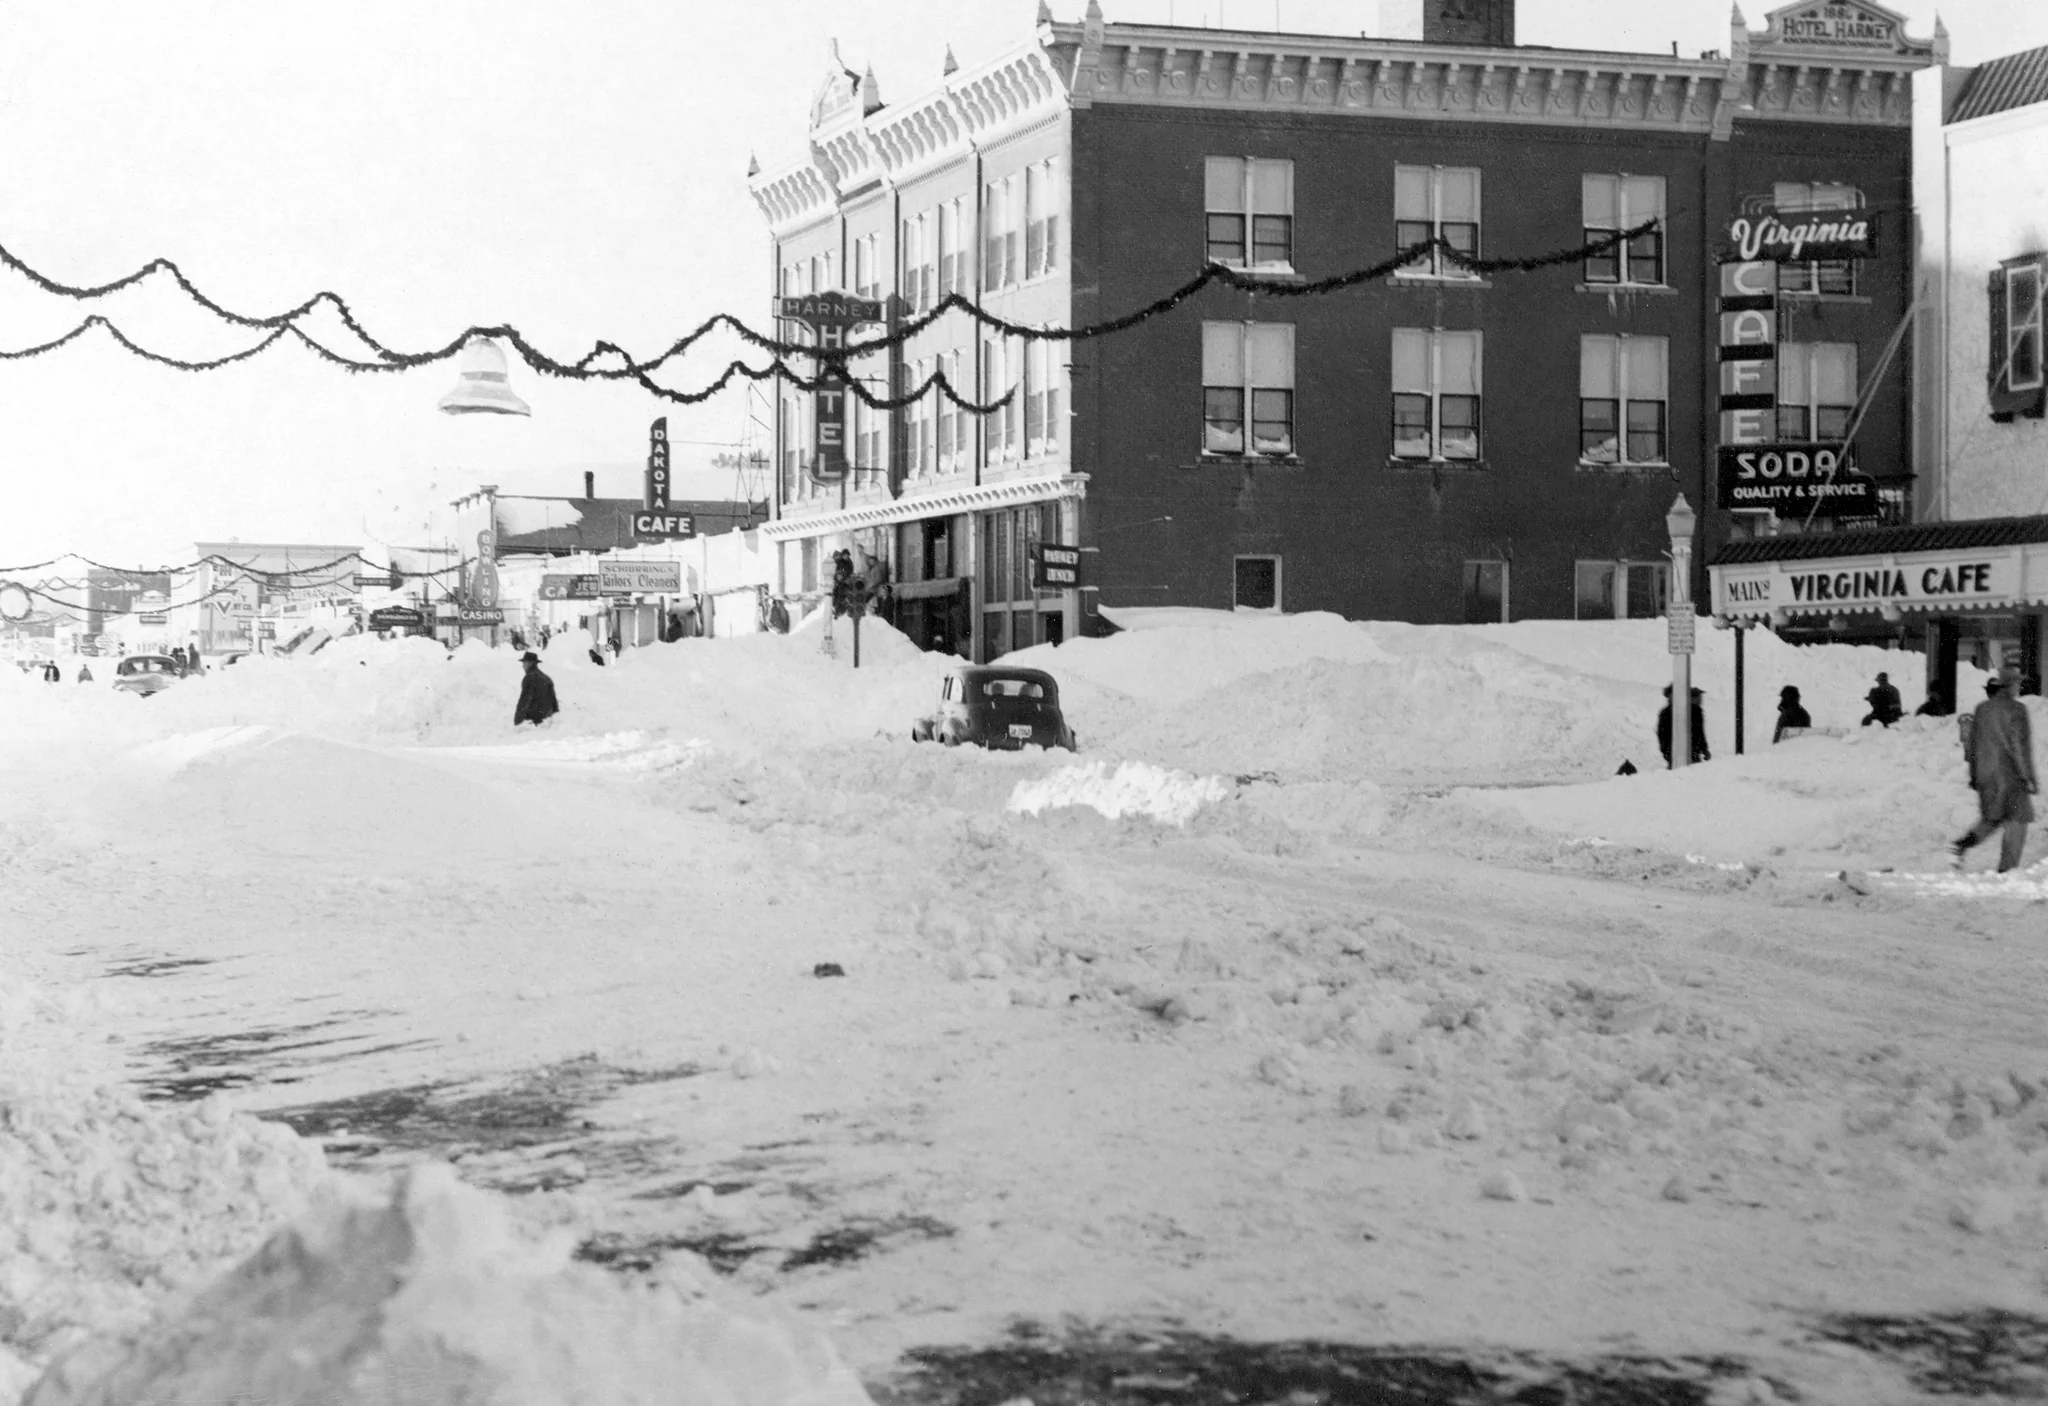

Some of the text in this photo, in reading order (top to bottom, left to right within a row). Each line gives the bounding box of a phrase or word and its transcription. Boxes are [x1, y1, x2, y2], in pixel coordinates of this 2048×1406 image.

[1783, 18, 1893, 40] HOTEL HARNEY
[1731, 215, 1867, 260] Virginia
[787, 301, 876, 317] HARNEY
[1733, 260, 1768, 444] CAFE
[819, 325, 842, 477] HTEL
[654, 430, 665, 508] DAKOTA
[1737, 450, 1836, 479] SODA
[1733, 485, 1792, 499] QUALITY
[1795, 485, 1805, 497] &
[1808, 483, 1866, 497] SERVICE
[637, 516, 691, 533] CAFE
[482, 535, 491, 607] BOWLING
[1790, 569, 1908, 601] VIRGINIA
[1922, 563, 1991, 594] CAFE
[461, 611, 502, 620] CASINO
